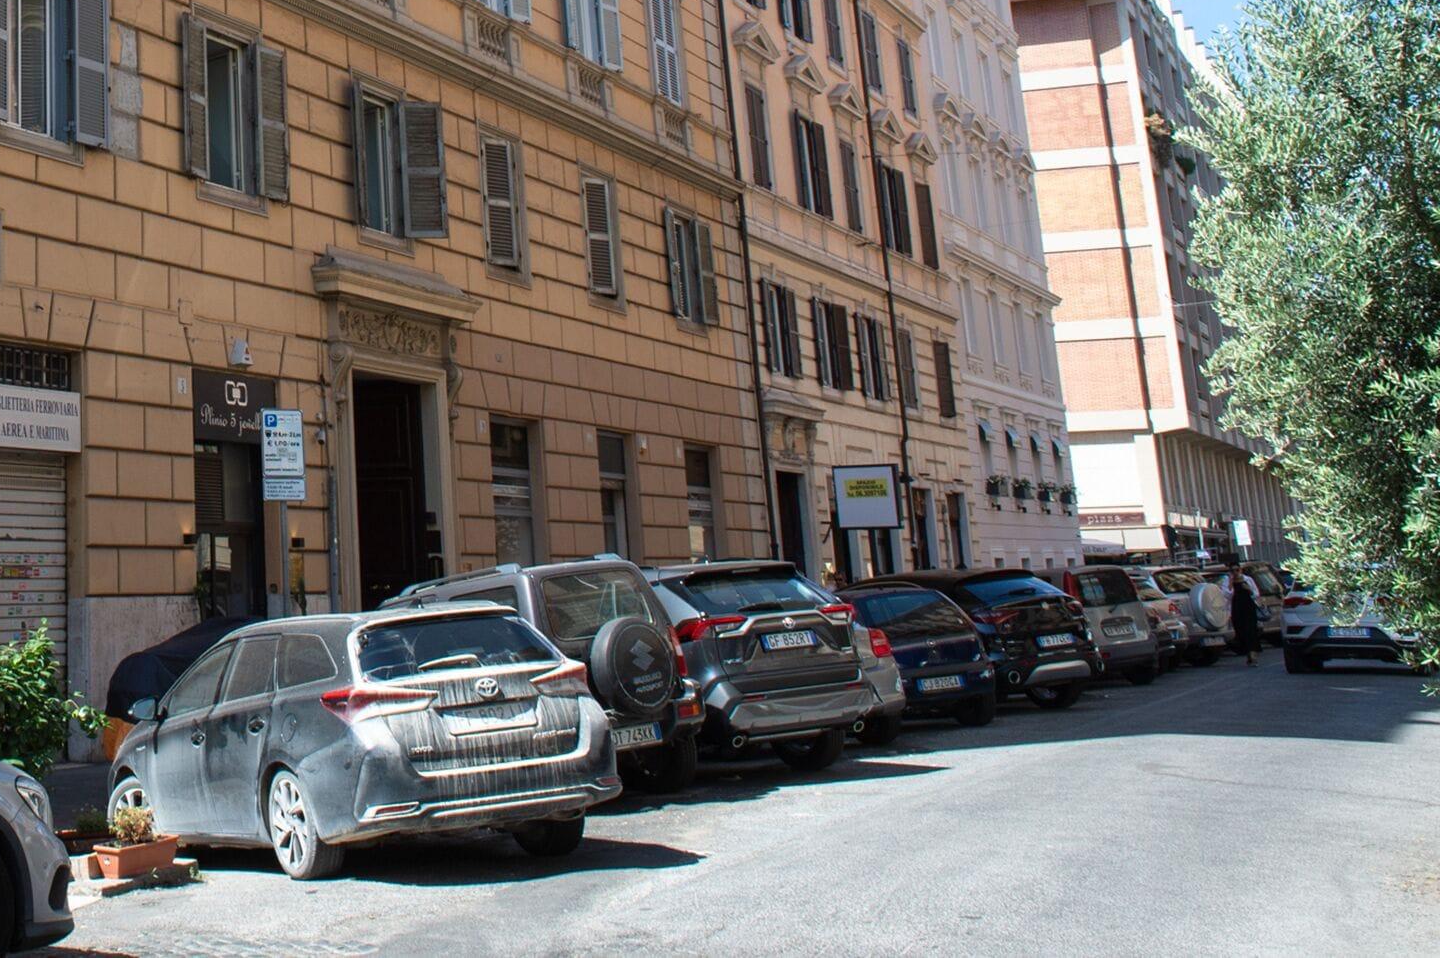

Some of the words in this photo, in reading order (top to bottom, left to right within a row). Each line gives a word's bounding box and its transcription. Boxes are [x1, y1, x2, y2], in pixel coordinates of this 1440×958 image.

[35, 399, 79, 417] FERROVIARIA
[201, 403, 228, 427] Plinio
[230, 413, 237, 428] 5
[1, 423, 28, 438] AEREA
[30, 425, 35, 438] E
[36, 426, 70, 442] MARITTIMA
